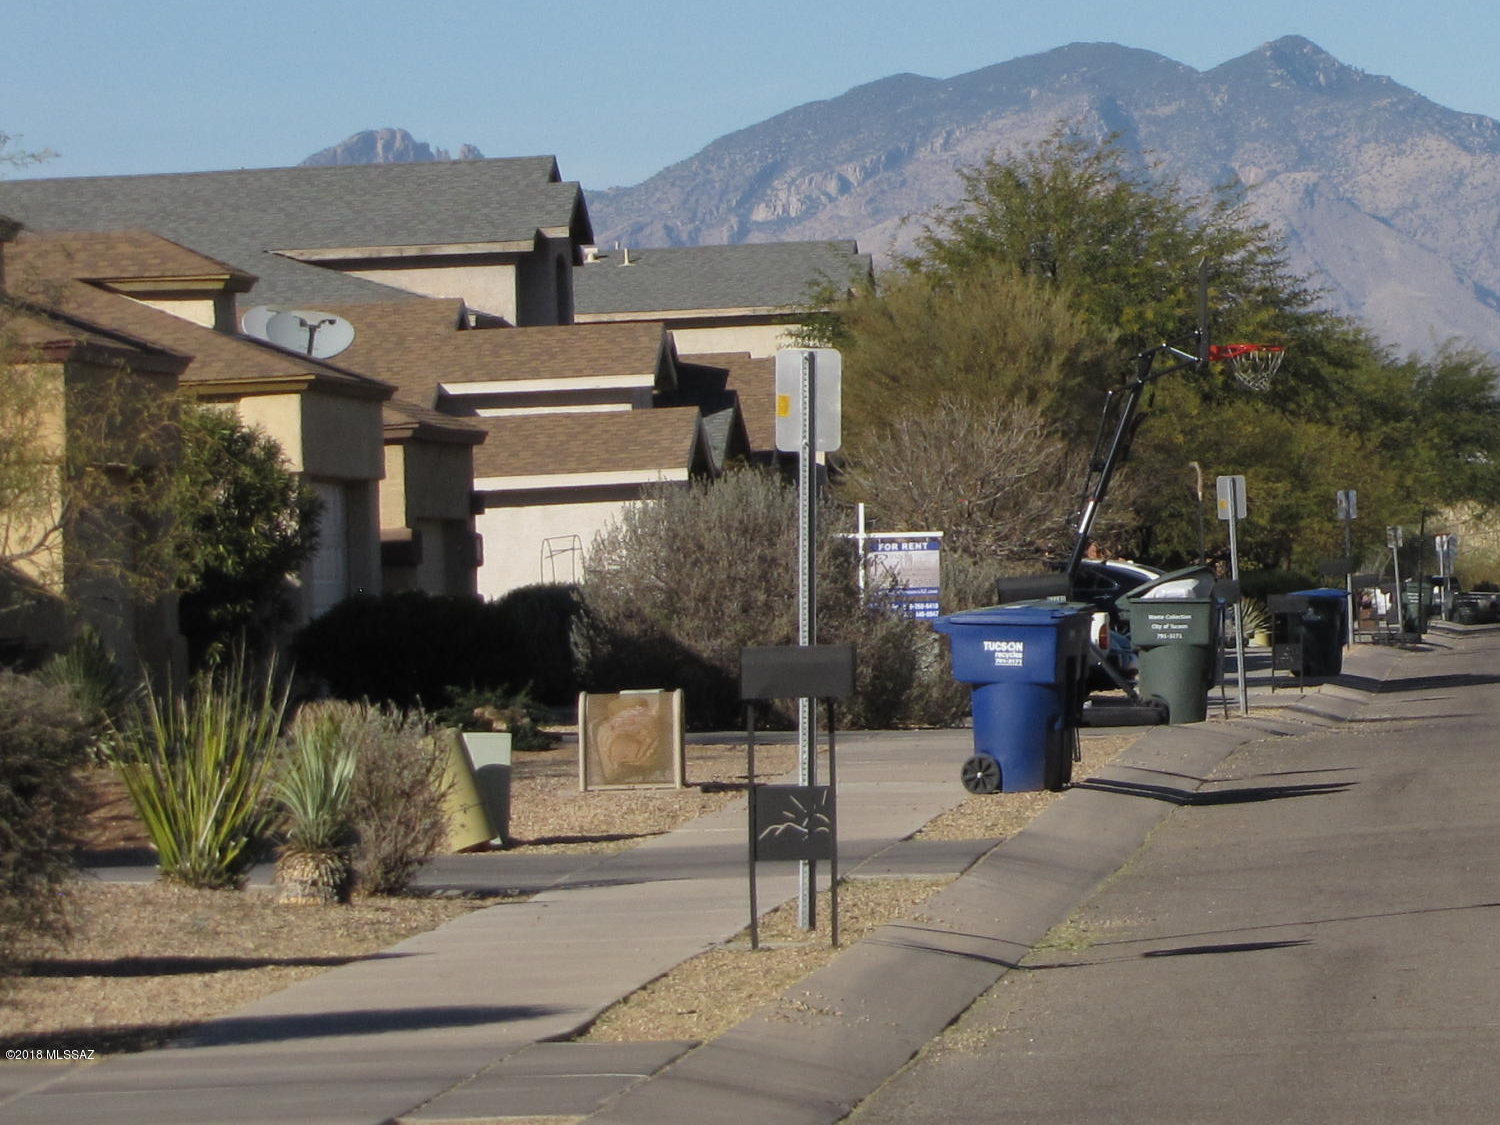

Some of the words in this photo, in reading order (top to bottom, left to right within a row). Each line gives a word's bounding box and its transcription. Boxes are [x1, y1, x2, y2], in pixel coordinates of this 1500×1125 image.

[878, 542, 899, 551] FOR
[901, 541, 928, 550] RENT
[983, 640, 1024, 651] TUCSON
